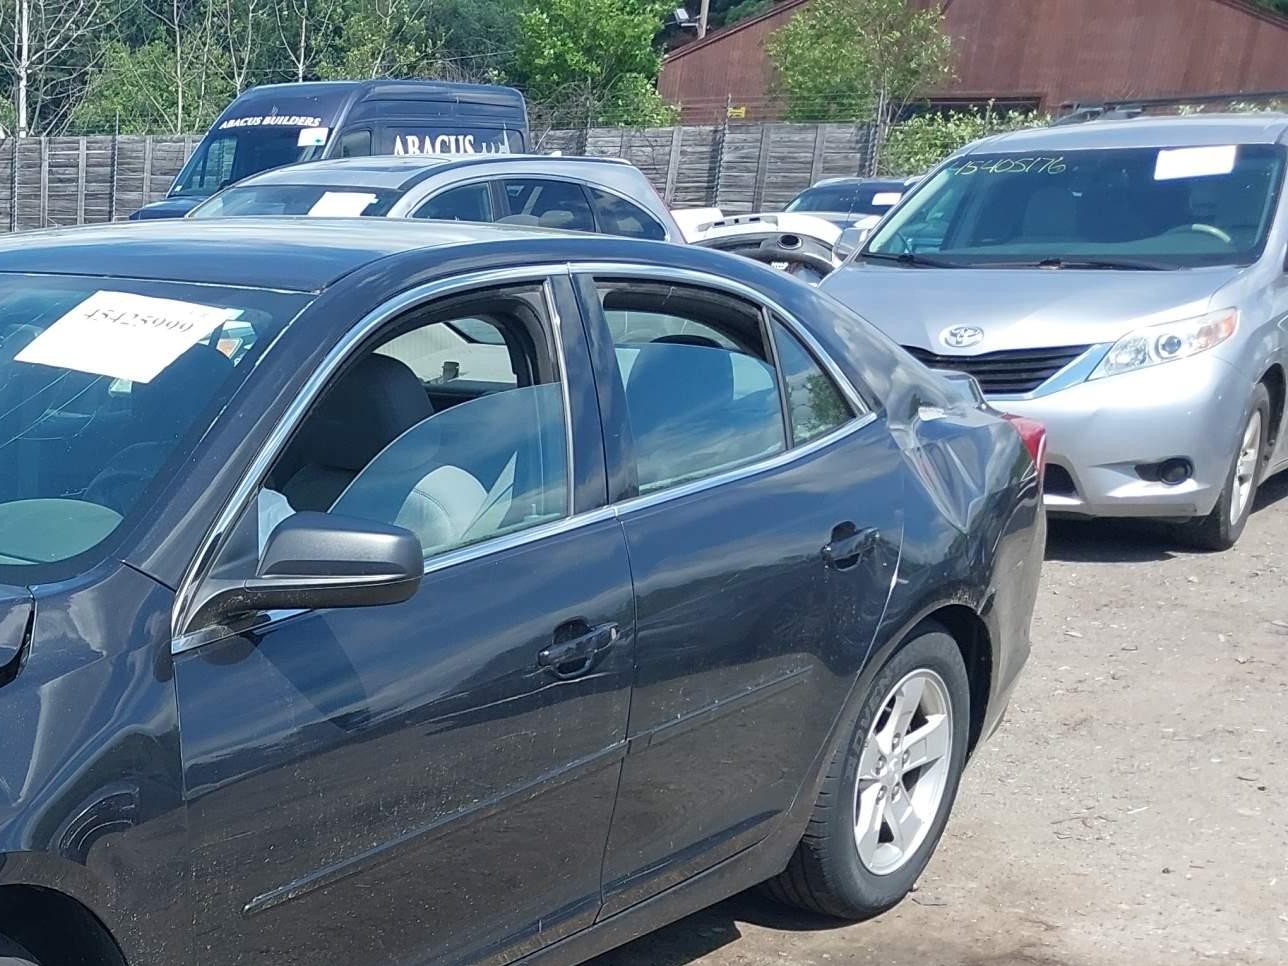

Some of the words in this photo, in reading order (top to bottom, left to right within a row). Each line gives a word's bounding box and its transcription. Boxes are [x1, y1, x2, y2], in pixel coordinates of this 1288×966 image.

[219, 116, 263, 129] ABACUS
[262, 115, 321, 127] BUILDERS
[394, 134, 476, 154] ABACUS
